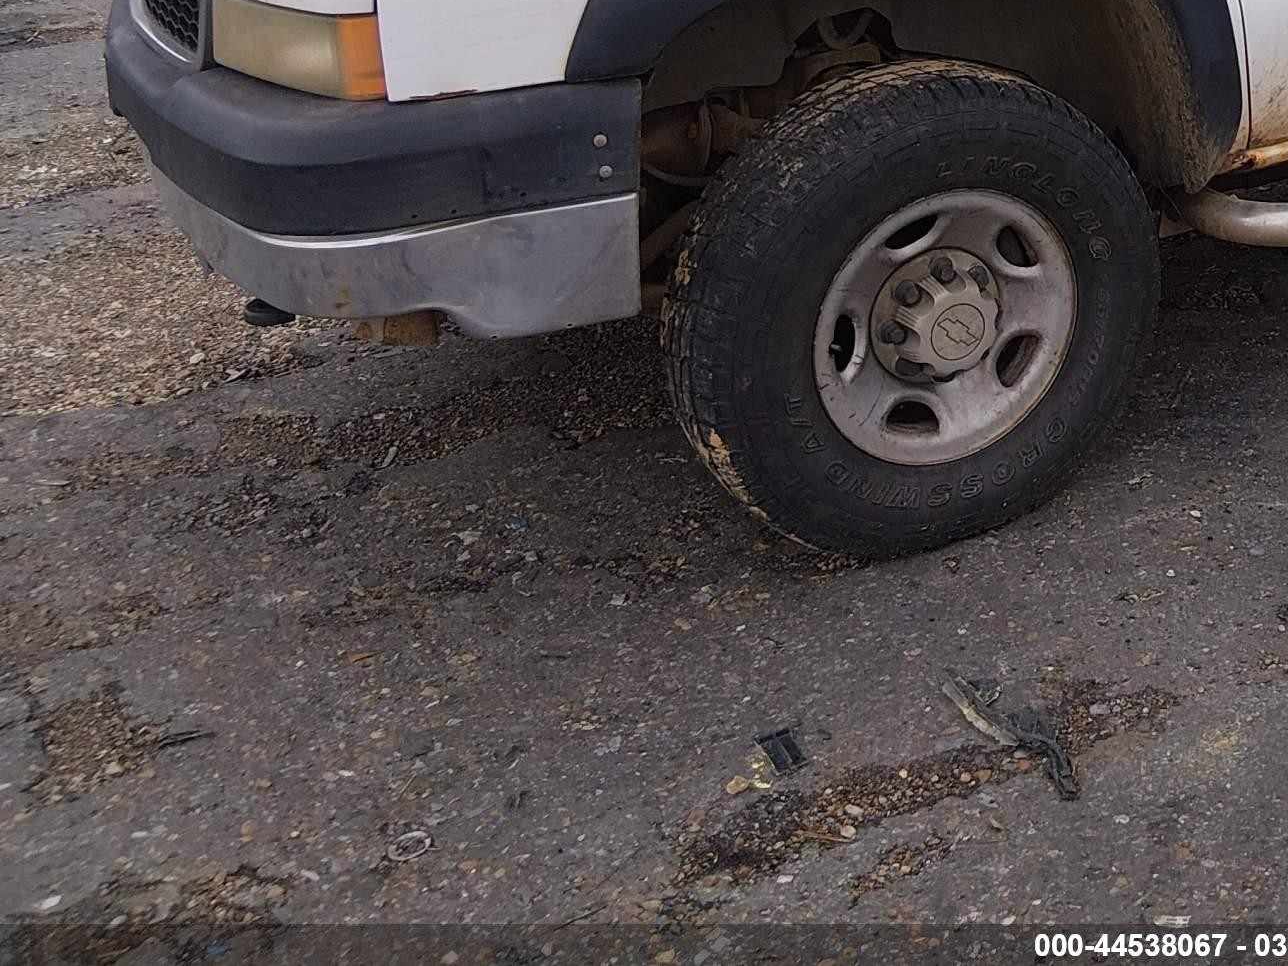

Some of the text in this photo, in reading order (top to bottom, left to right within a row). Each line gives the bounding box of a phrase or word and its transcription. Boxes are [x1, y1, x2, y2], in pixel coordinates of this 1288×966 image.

[935, 155, 1113, 262] LINGLONG
[785, 392, 1068, 509] CROSSWIND A/T
